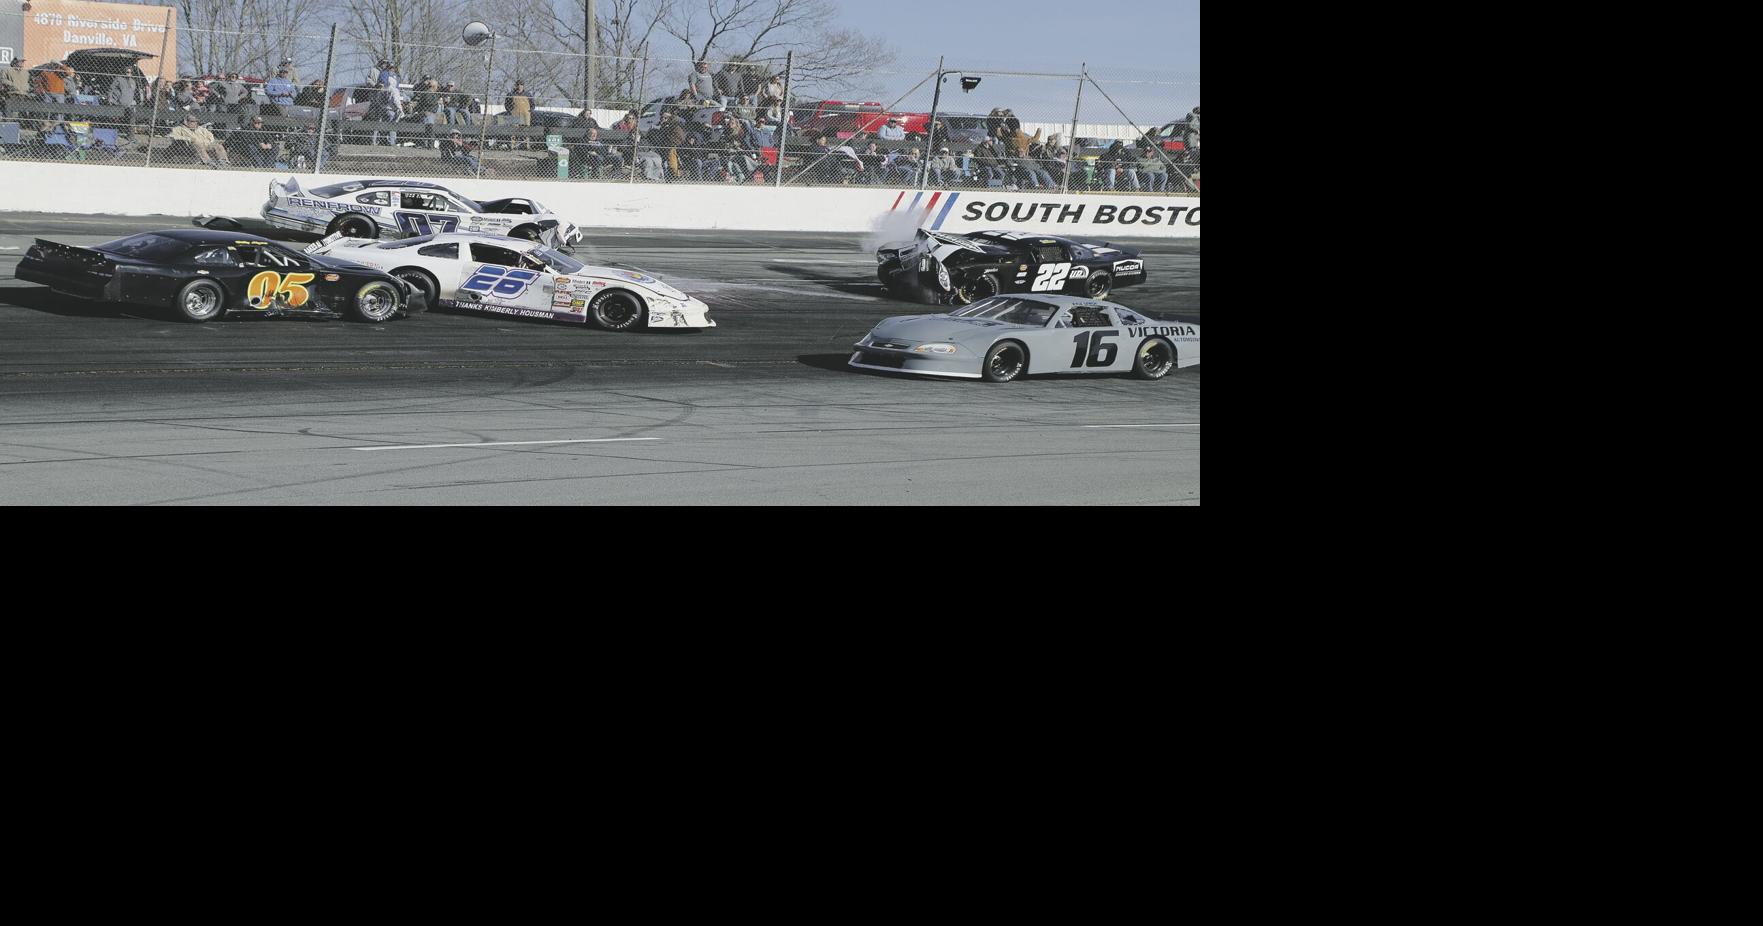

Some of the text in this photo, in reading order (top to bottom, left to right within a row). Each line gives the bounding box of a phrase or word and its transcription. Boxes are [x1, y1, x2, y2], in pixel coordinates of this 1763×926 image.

[68, 15, 128, 30] Riverside
[132, 18, 166, 33] Drive
[122, 33, 138, 48] VA
[287, 197, 382, 216] RENFROW
[961, 201, 1086, 223] SOUTH
[460, 263, 541, 300] 26
[1031, 262, 1072, 292] 22
[455, 301, 555, 320] THANKS KIMBERLY HOUSMAN
[1127, 325, 1196, 338] VICTORIA
[1070, 330, 1120, 368] 16
